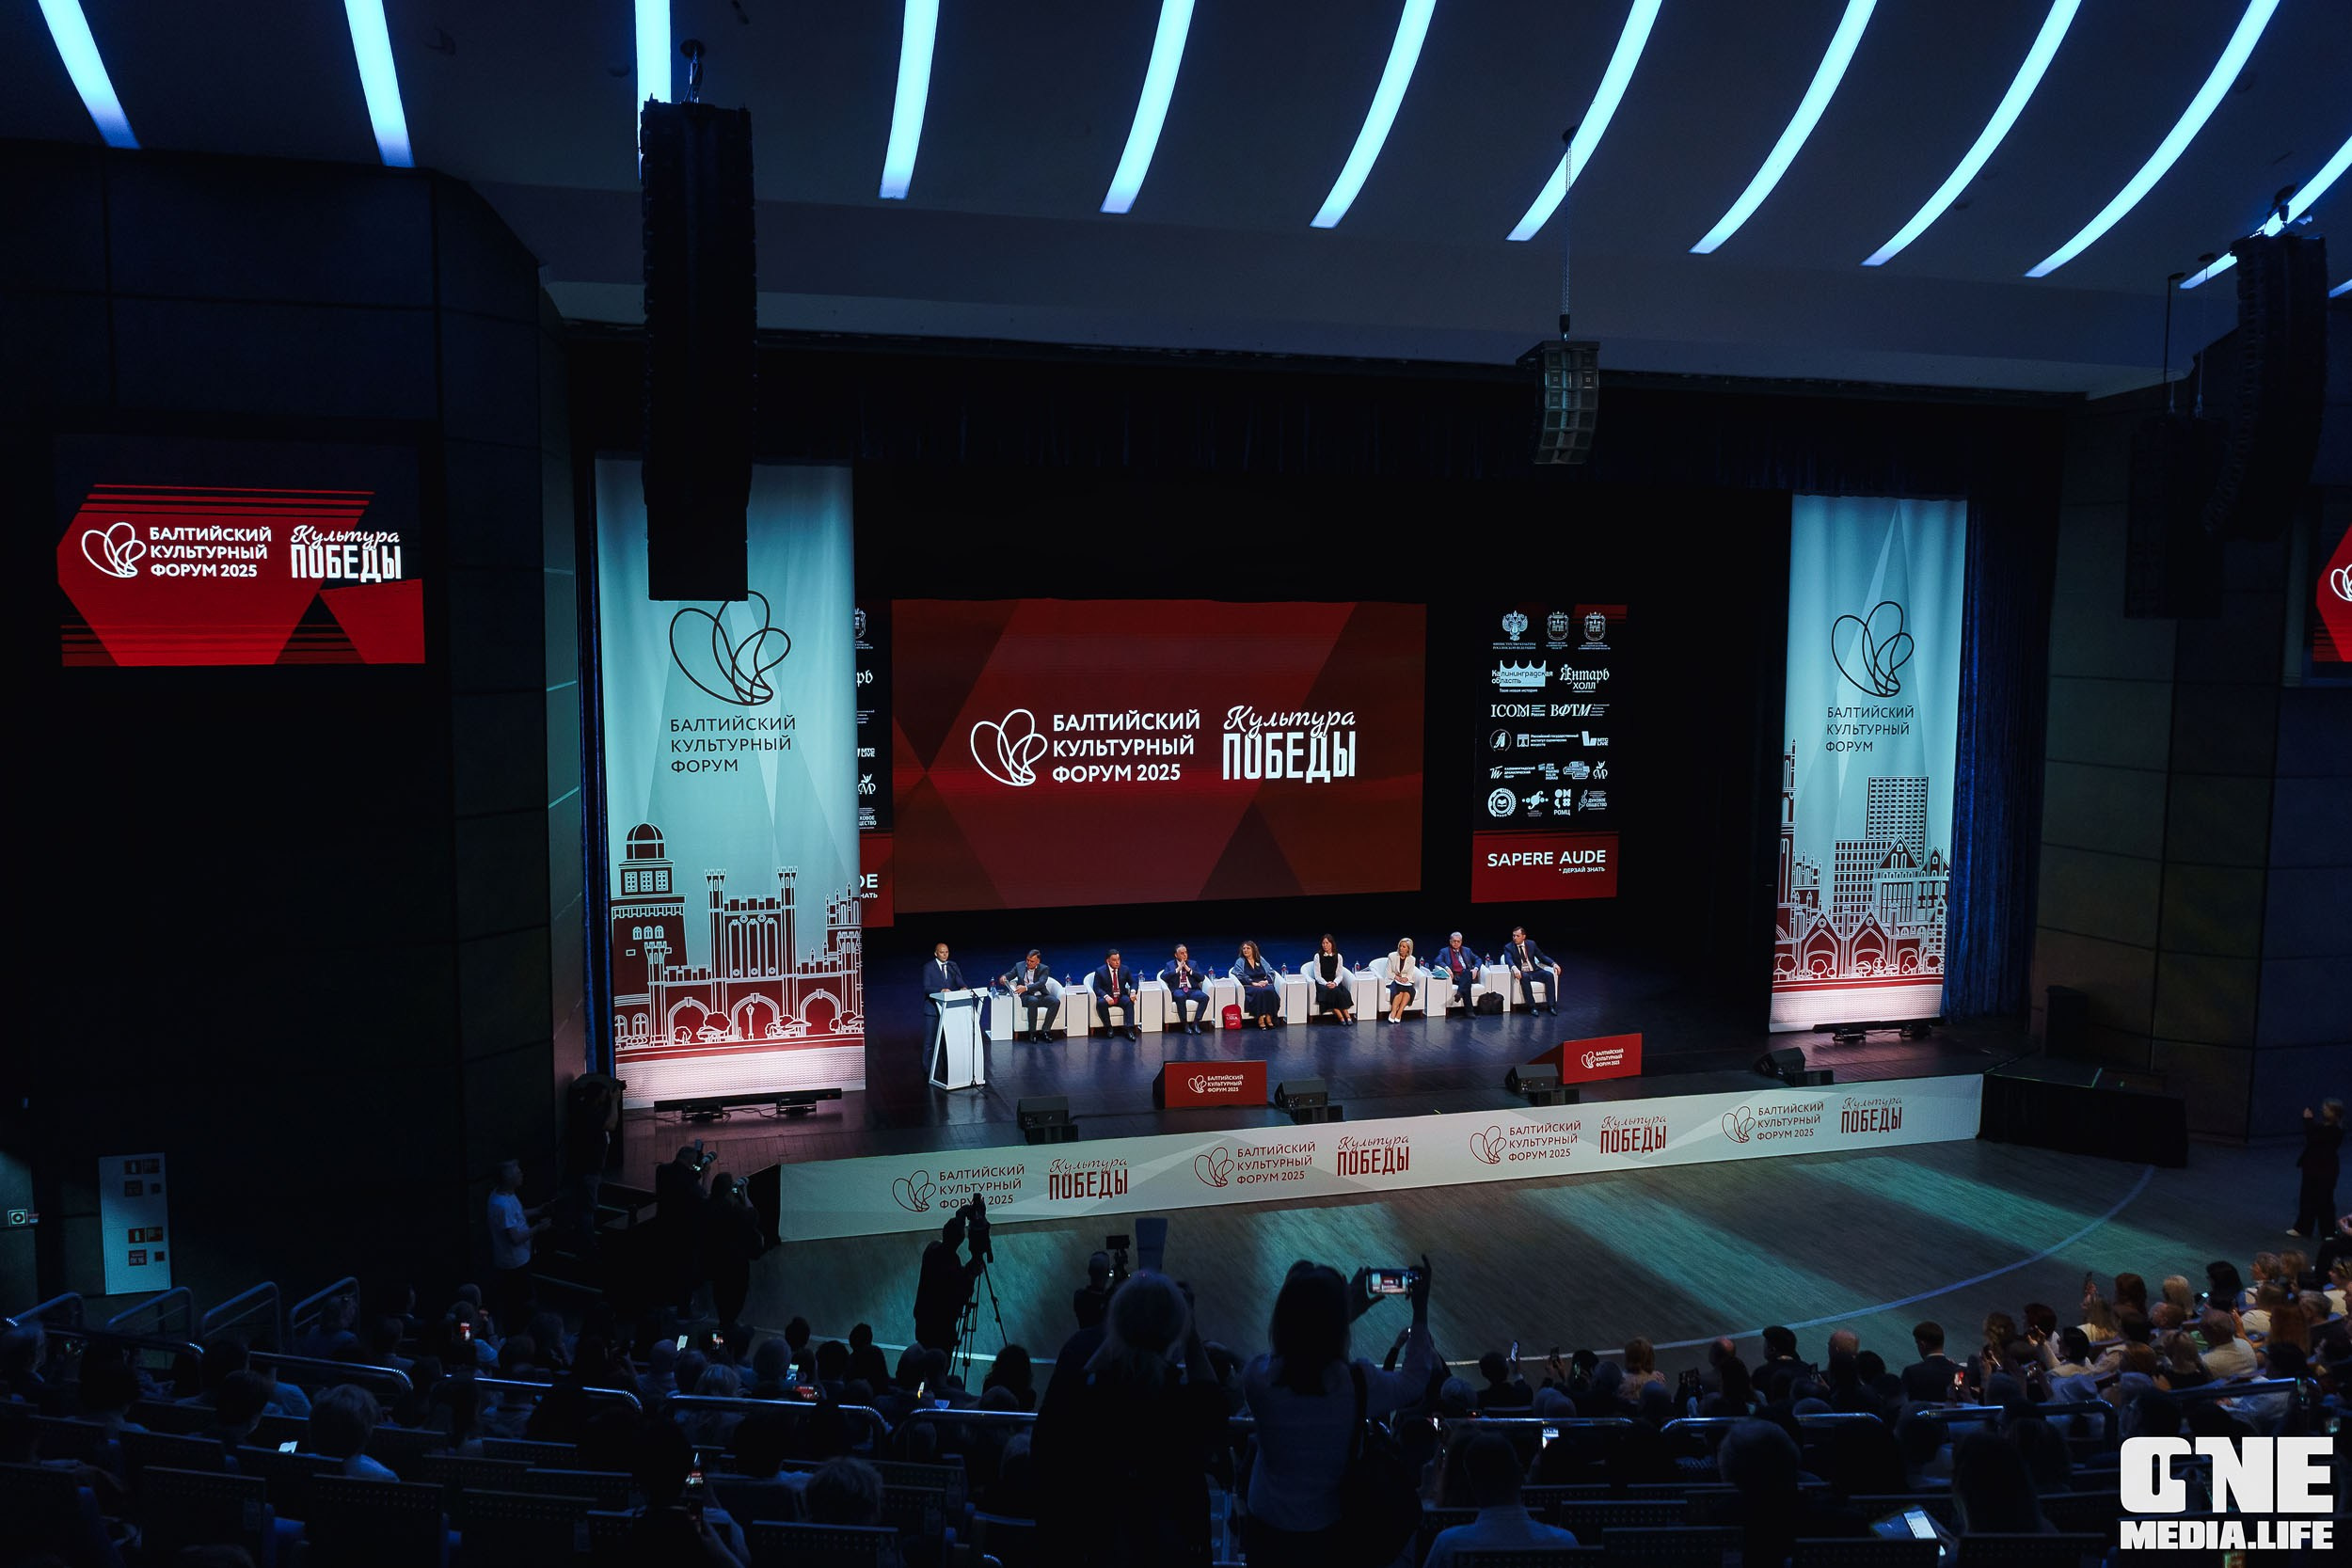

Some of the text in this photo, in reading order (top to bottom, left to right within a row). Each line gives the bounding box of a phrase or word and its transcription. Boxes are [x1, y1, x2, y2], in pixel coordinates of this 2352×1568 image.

[150, 526, 272, 543] БАЛТИЙСКИЙ
[291, 524, 400, 549] Культура
[150, 544, 268, 560] КУЛЬТУРНЫЙ
[151, 563, 258, 578] ФОРУМ 2025
[291, 544, 402, 582] ПОБЕДЫ
[1491, 670, 1553, 679] Калининградская
[1490, 704, 1530, 717] ICOM
[1827, 705, 1915, 718] БАЛТИЙСКИЙ
[670, 715, 796, 732] БАЛТИЙСКИЙ
[1053, 708, 1200, 732] БАЛТИЙСКИЙ
[1223, 705, 1356, 737] Культура
[1826, 721, 1910, 735] КУЛЬТУРНЫЙ
[671, 735, 791, 752] КУЛЬТУРНЫЙ
[1053, 734, 1195, 758] КУЛЬТУРНЫЙ
[1826, 741, 1873, 752] ФОРУМ
[1222, 730, 1356, 784] ПОБЕДЫ
[671, 759, 738, 773] ФОРУМ
[1052, 763, 1181, 784] ФОРУМ 2025
[1487, 849, 1606, 866] SAPERE AUDE
[1758, 1101, 1824, 1117] БАЛТИЙСКИЙ
[1842, 1097, 1902, 1113] Культура
[1509, 1119, 1581, 1136] БАЛТИЙСКИЙ
[1601, 1115, 1667, 1132] Культура
[1757, 1114, 1820, 1129] КУЛЬТУРНЫЙ
[1841, 1107, 1902, 1133] ПОБЕДЫ
[1509, 1133, 1578, 1148] КУЛЬТУРНЫЙ
[1600, 1125, 1667, 1154] ПОБЕДЫ
[1757, 1128, 1814, 1141] ФОРУМ 2025
[1237, 1140, 1316, 1158] БАЛТИЙСКИЙ
[1338, 1135, 1409, 1152] Культура
[1237, 1156, 1312, 1171] КУЛЬТУРНЫЙ
[1337, 1146, 1409, 1177] ПОБЕДЫ
[1508, 1148, 1571, 1162] ФОРУМ 2025
[939, 1164, 1025, 1181] БАЛТИЙСКИЙ
[1049, 1158, 1128, 1177] Культура
[1049, 1168, 1128, 1200] ПОБЕДЫ
[1236, 1170, 1305, 1185] ФОРУМ 2025
[939, 1179, 1022, 1196] КУЛЬТУРНЫЙ
[939, 1195, 1014, 1210] ФОРУ 2025
